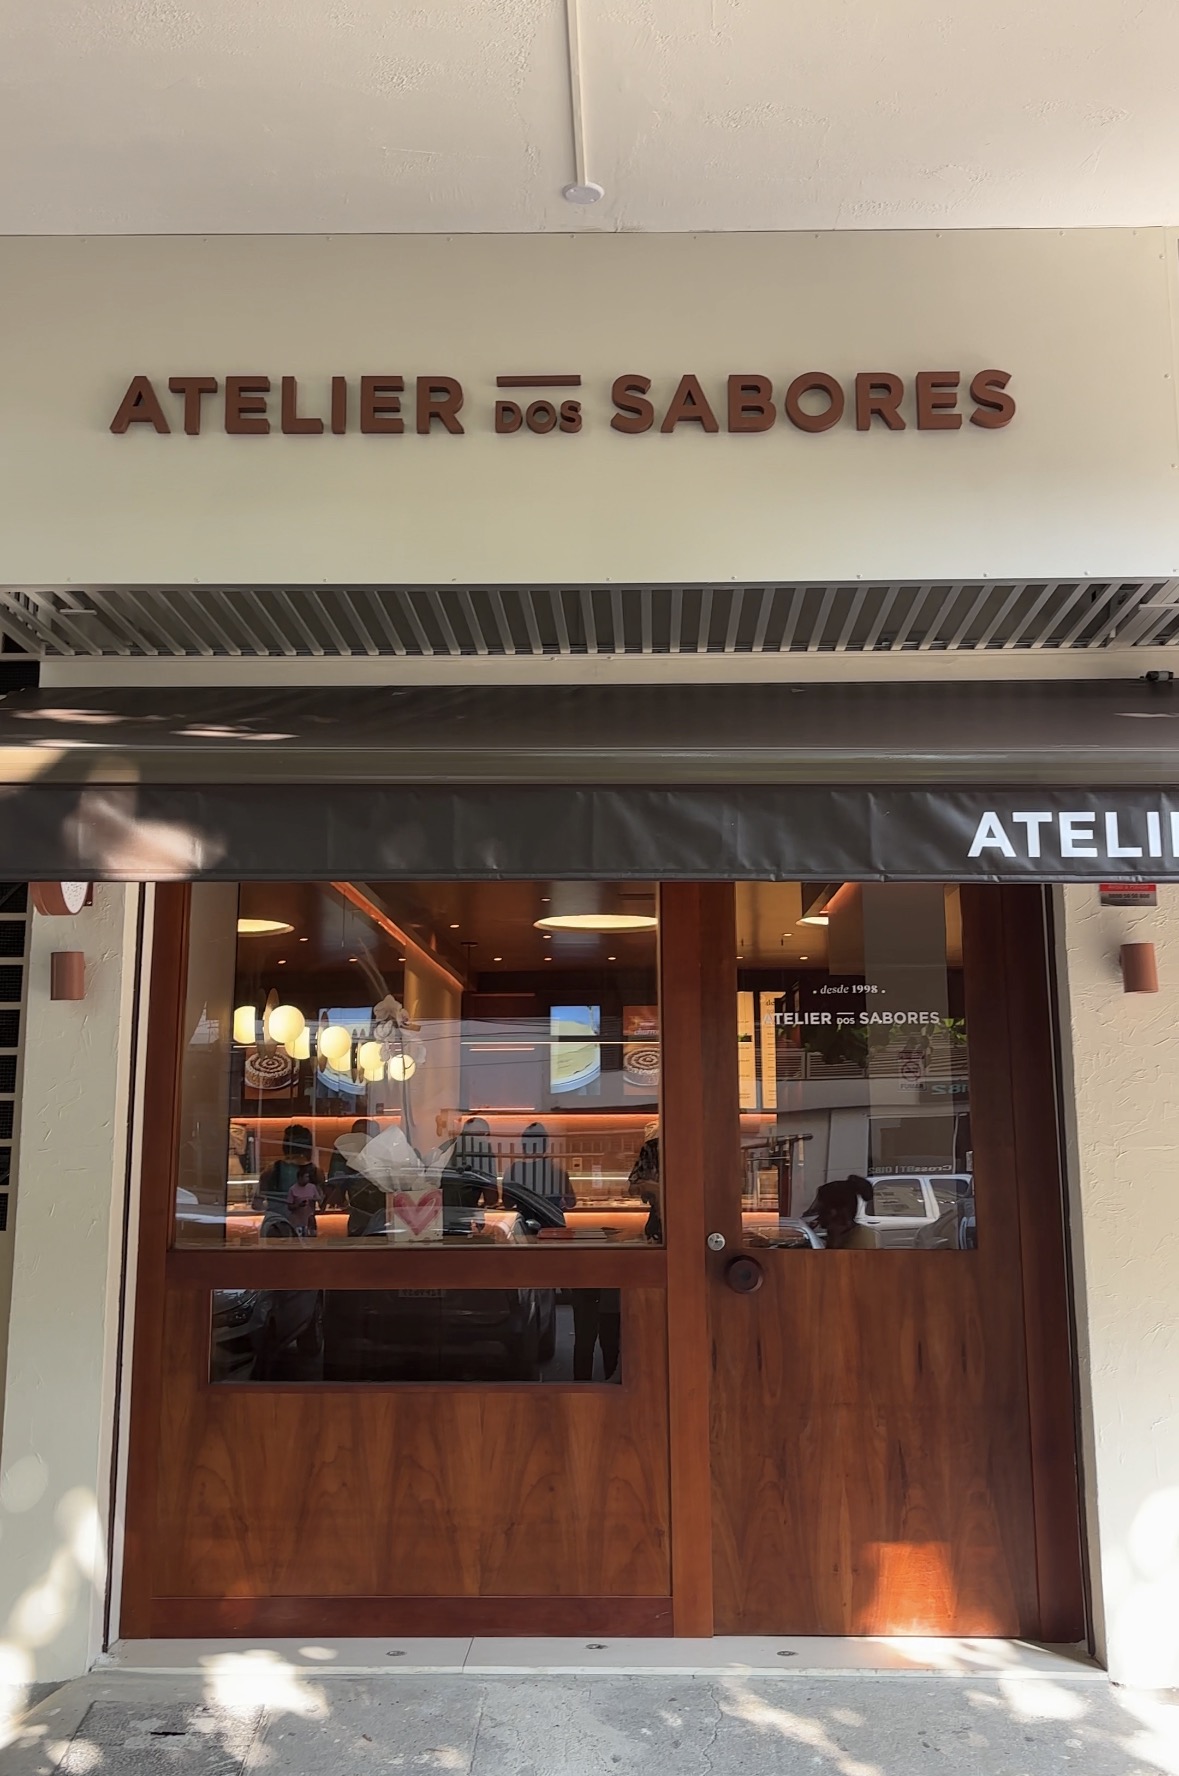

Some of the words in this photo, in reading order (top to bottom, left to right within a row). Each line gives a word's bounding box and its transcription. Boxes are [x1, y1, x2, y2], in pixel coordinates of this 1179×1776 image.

[109, 375, 465, 435] ATELIER
[495, 399, 583, 433] DOS
[610, 369, 1017, 433] SABORES
[820, 985, 849, 995] desde
[852, 985, 878, 994] 1998
[763, 1012, 832, 1025] ATELIER
[837, 1017, 855, 1025] DOS
[859, 1011, 940, 1024] SABORES
